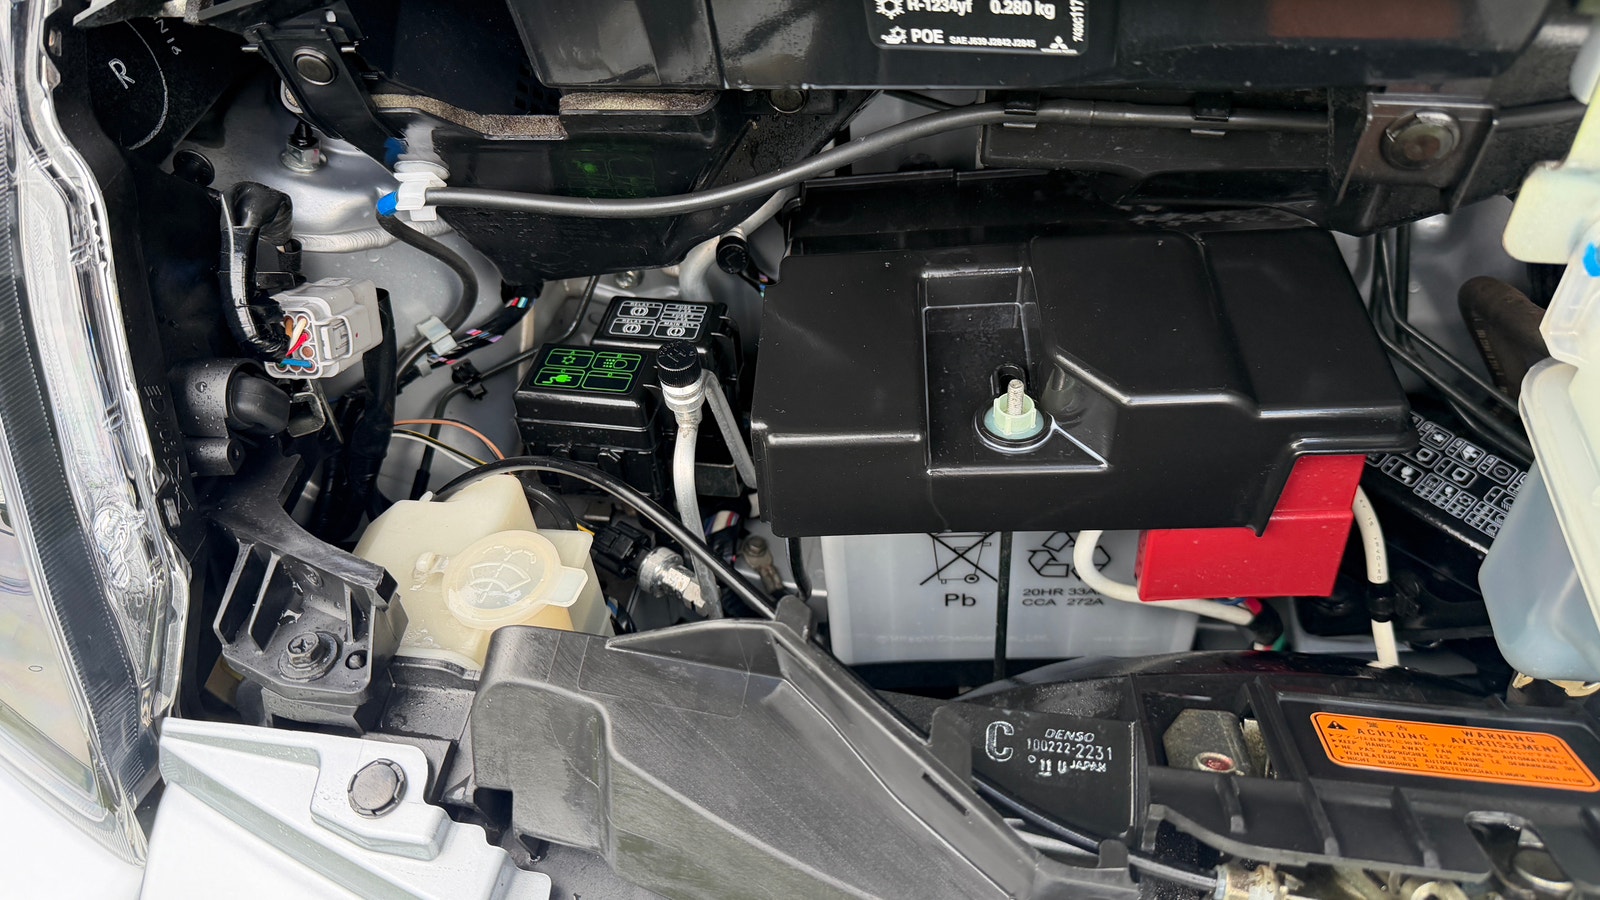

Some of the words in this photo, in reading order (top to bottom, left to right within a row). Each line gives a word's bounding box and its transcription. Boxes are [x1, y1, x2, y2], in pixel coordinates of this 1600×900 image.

[906, 0, 973, 16] R-1234yf
[989, 0, 1032, 15] 0.280
[1034, 0, 1056, 20] kg
[910, 28, 945, 44] POE
[949, 36, 967, 45] SAE
[108, 58, 135, 89] R
[1023, 588, 1063, 596] 20HR
[1068, 588, 1102, 596] 33A
[944, 593, 977, 607] Pb
[1022, 598, 1057, 606] CCA
[1067, 598, 1104, 606] 272A
[985, 721, 1015, 762] C
[1045, 728, 1095, 743] DENSO
[1355, 728, 1429, 740] ACHTUNG
[1460, 730, 1536, 742] WARNING
[1026, 738, 1113, 761] 100222-2231
[1448, 737, 1562, 752] AVERTISSEMENT
[1070, 760, 1107, 773] JAPAN
